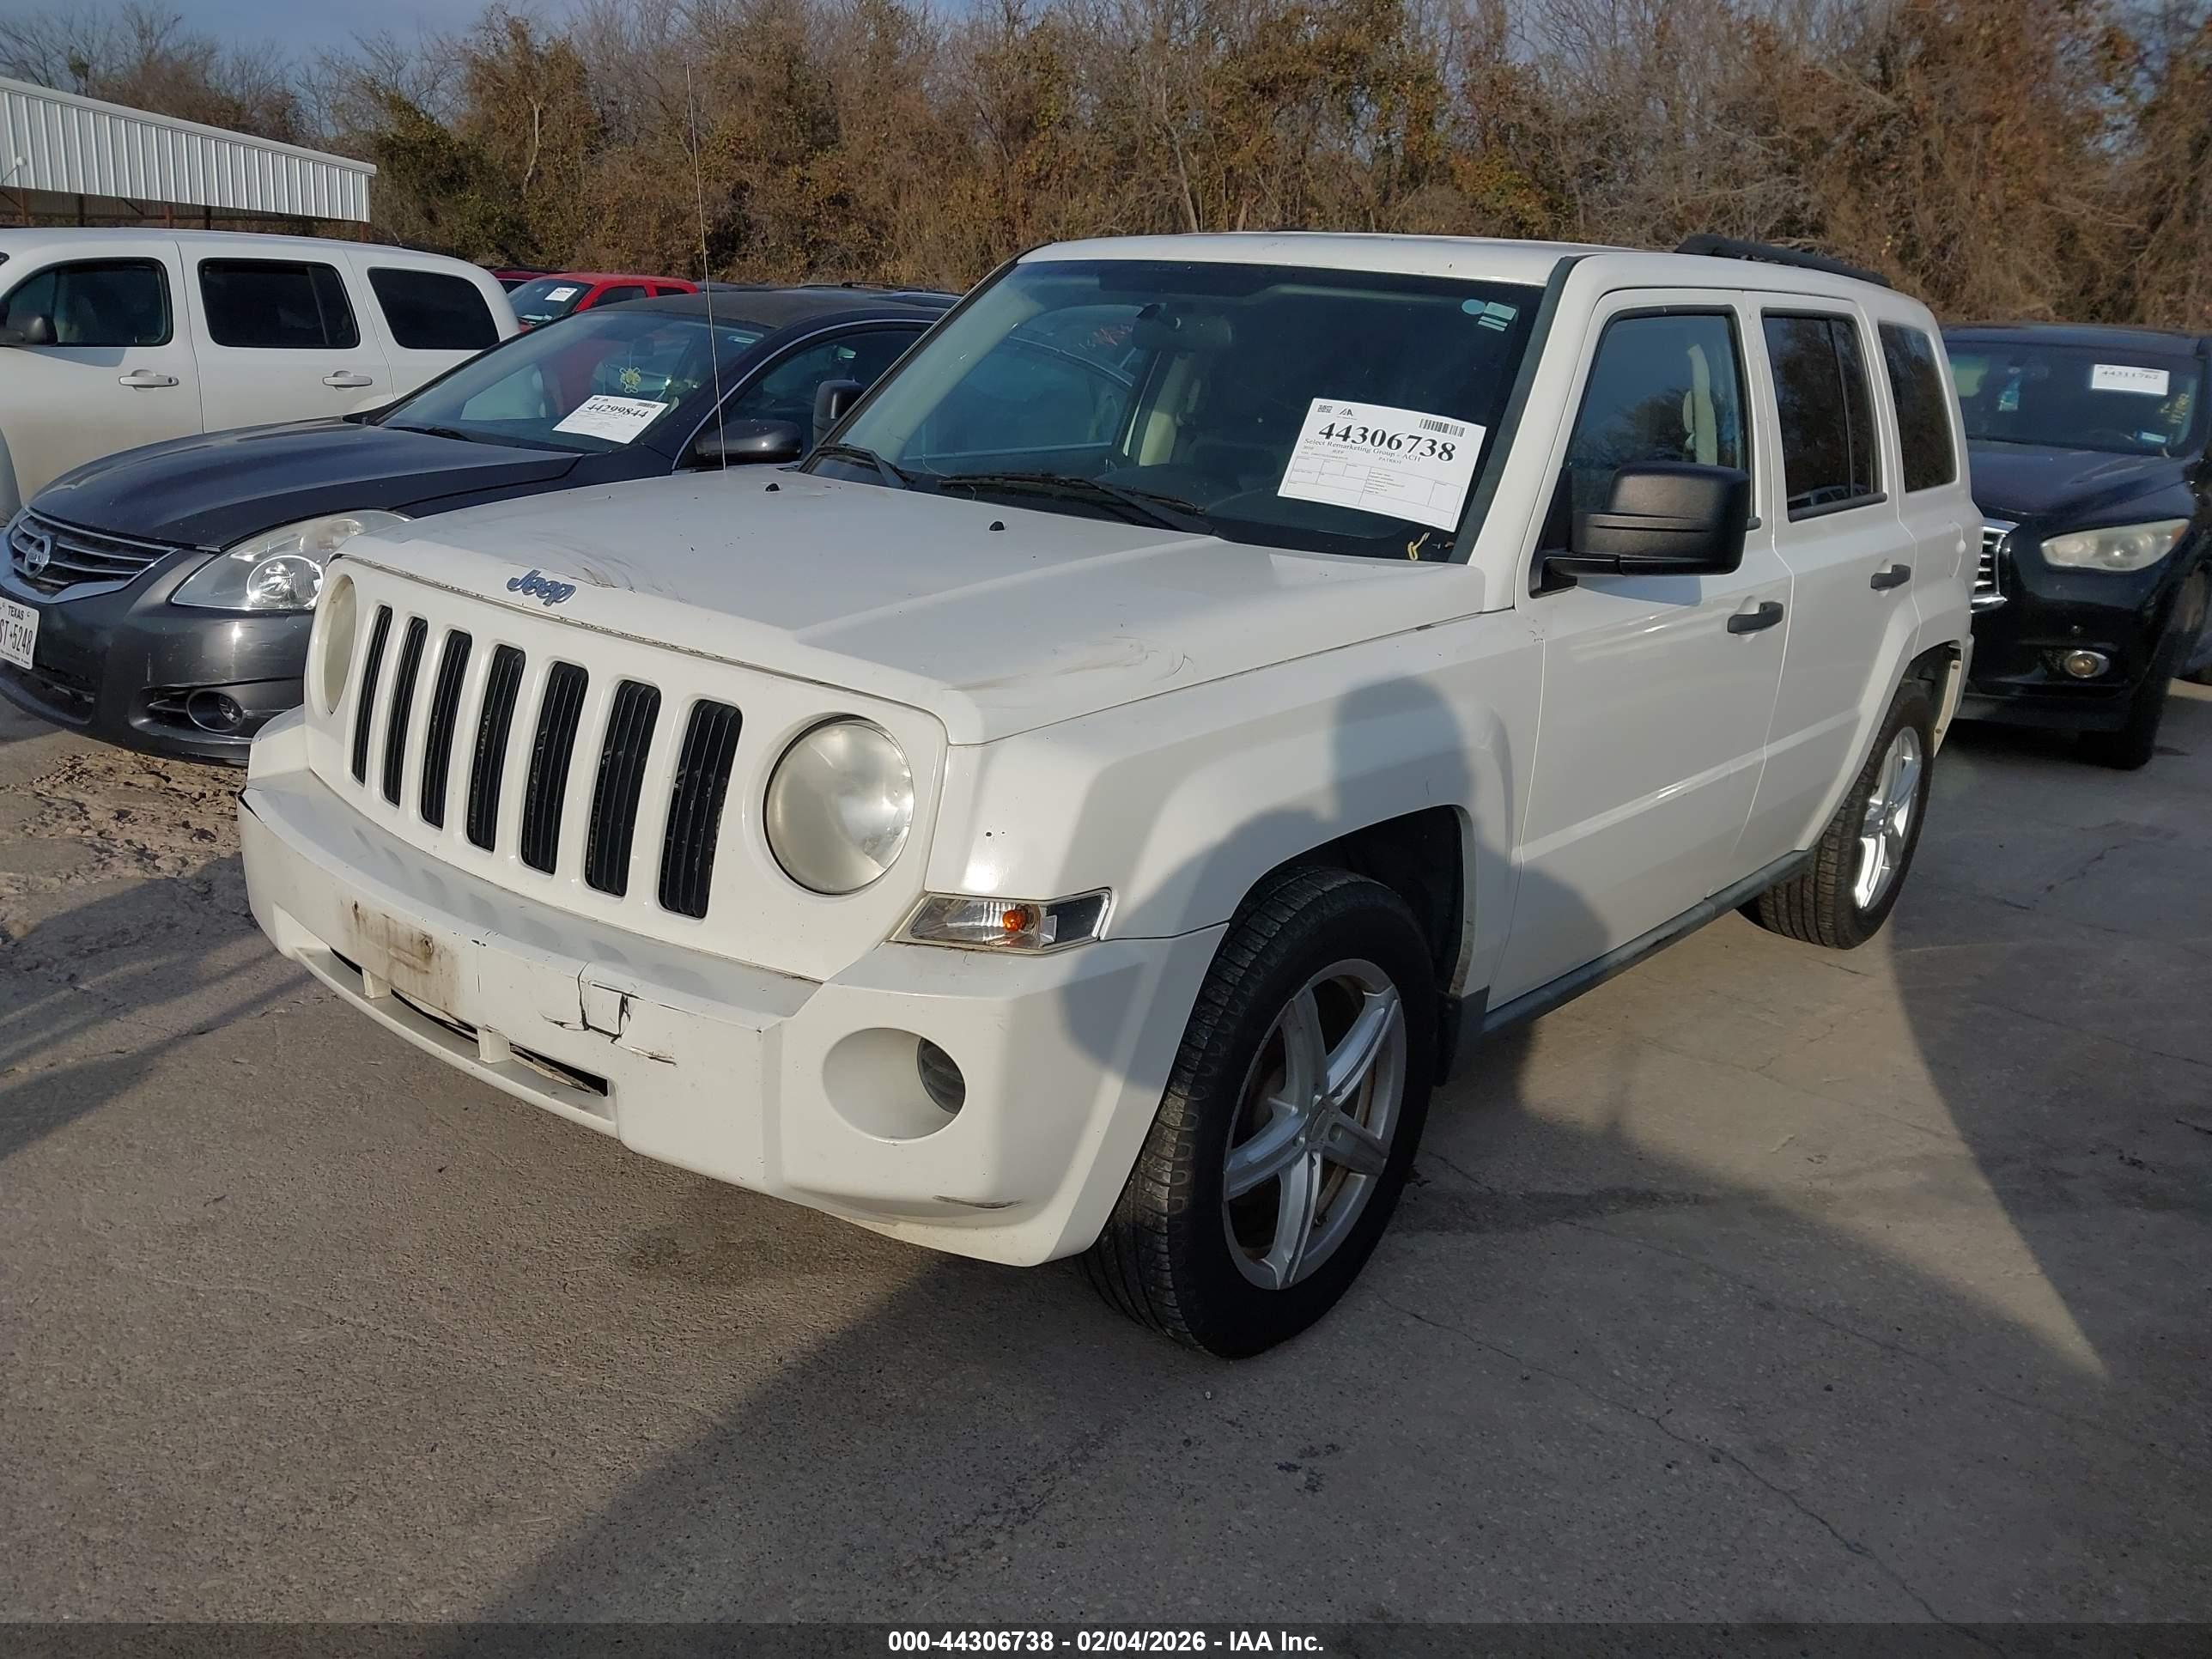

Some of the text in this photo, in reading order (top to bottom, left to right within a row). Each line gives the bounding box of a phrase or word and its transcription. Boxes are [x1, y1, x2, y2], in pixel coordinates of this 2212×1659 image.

[587, 404, 649, 418] 44299844
[1318, 422, 1456, 462] 44306738
[1327, 441, 1370, 453] Remarketing
[1373, 447, 1395, 457] Group
[1402, 453, 1421, 462] ACH
[506, 569, 576, 606] Jeep
[8, 605, 25, 621] TEXAS
